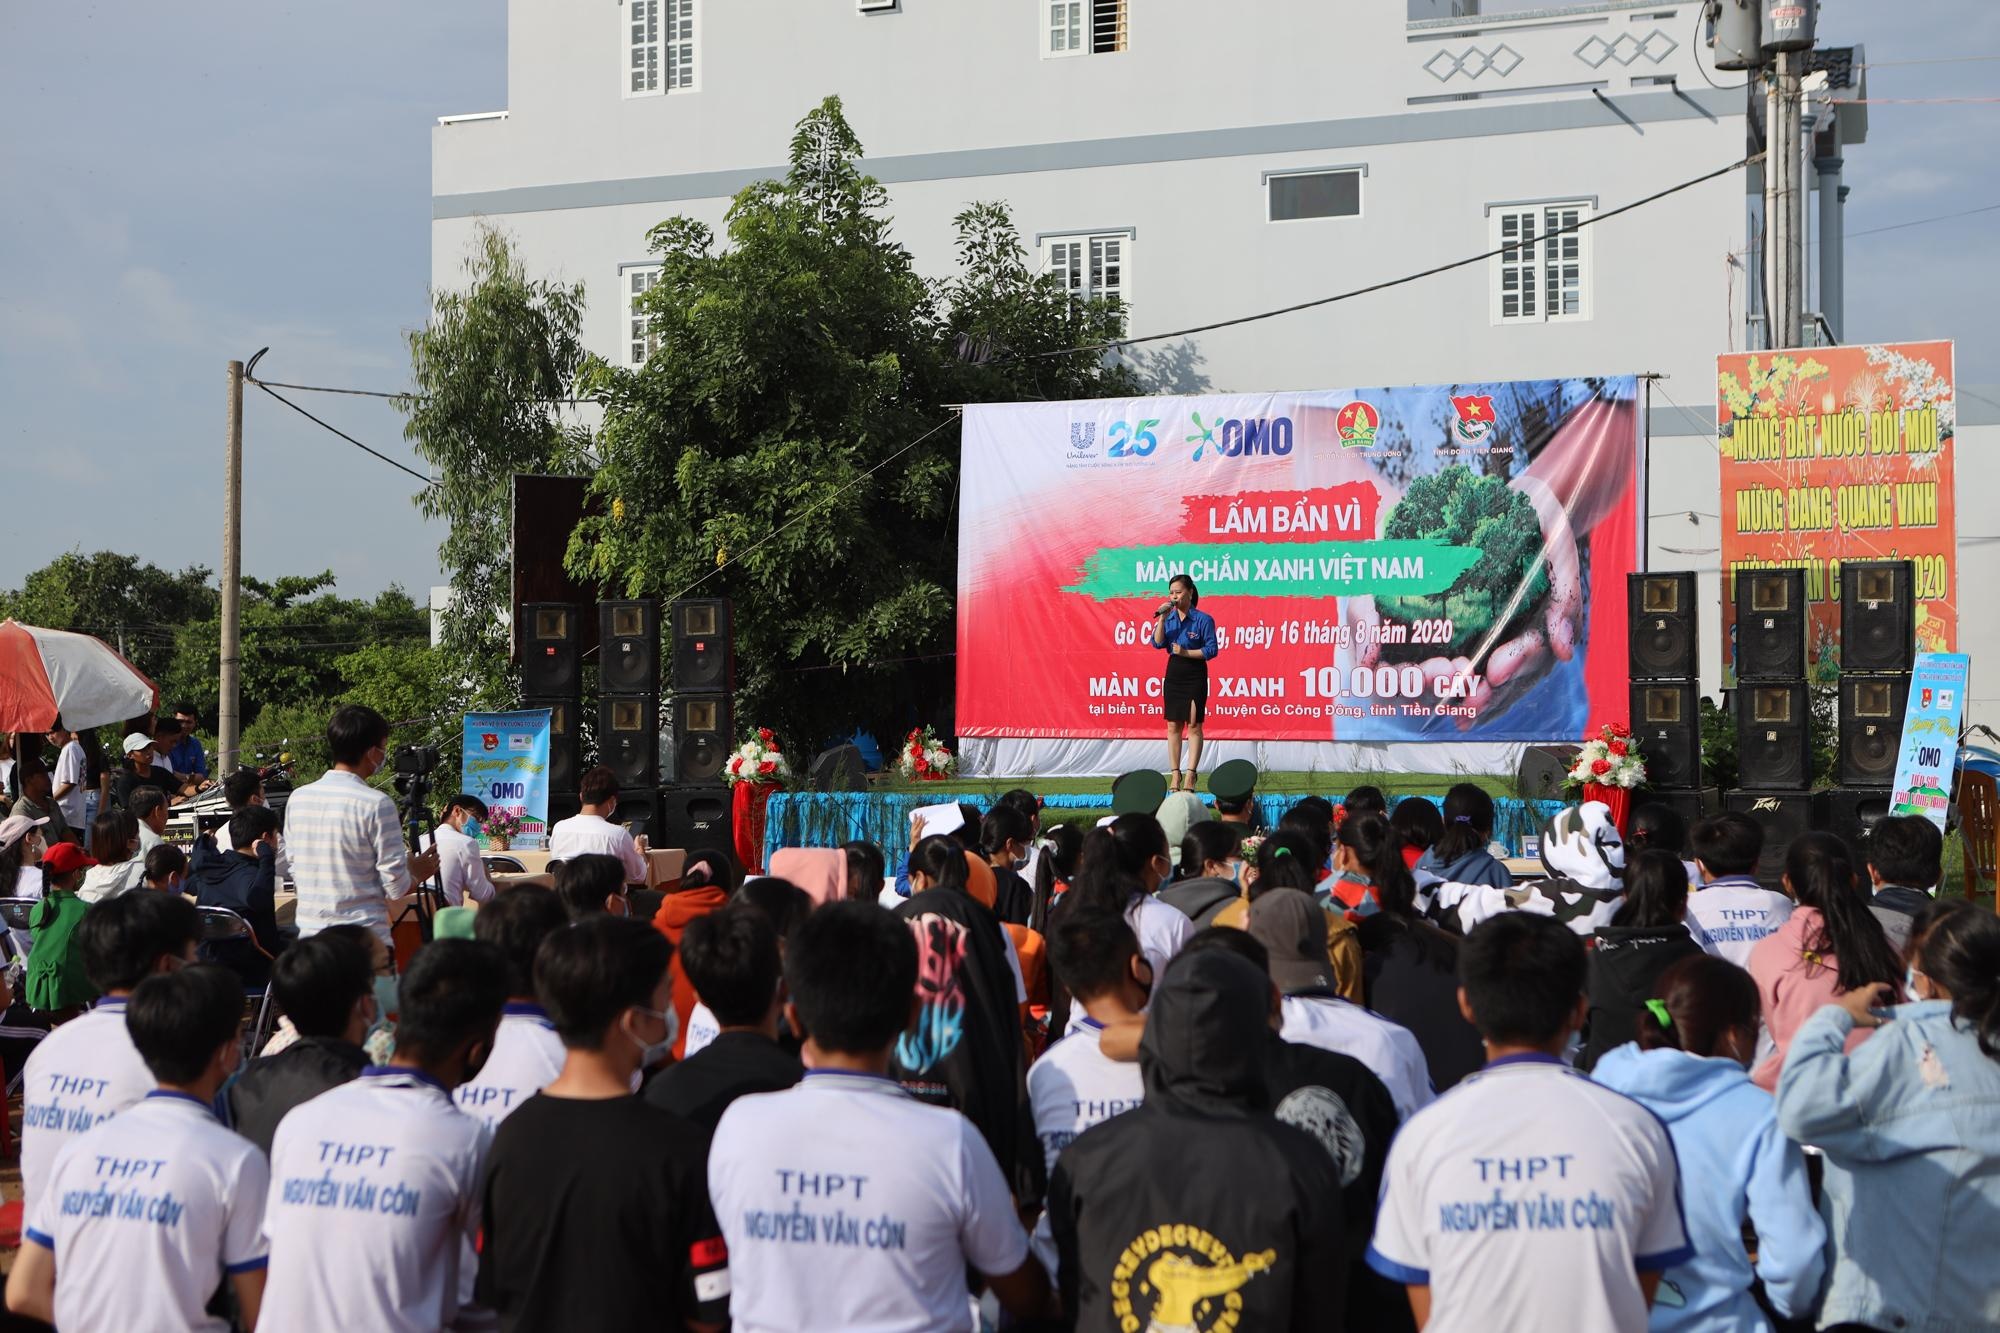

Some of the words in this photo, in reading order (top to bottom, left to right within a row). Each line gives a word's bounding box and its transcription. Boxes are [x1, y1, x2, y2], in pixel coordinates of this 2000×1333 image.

[1107, 419, 1161, 458] 25
[1222, 416, 1294, 457] OMO
[1734, 413, 1781, 463] MỪNG
[1785, 401, 1817, 460] ĐẤT
[1821, 404, 1868, 458] NƯỚC
[1871, 397, 1901, 456] ĐỔI
[1905, 405, 1938, 455] MỚI
[1490, 446, 1514, 454] GIANG
[1209, 499, 1267, 534] LẤM
[1272, 496, 1328, 532] BẨN
[1334, 497, 1361, 531] VÌ
[1736, 483, 1785, 534] MỪNG
[1788, 477, 1833, 531] ĐẢNG
[1837, 483, 1894, 534] QUANG
[1896, 482, 1938, 528] VINH
[1136, 556, 1184, 582] MÀN
[1188, 552, 1250, 581] CHẮN
[1254, 558, 1314, 581] XANH
[1319, 552, 1367, 585] VIỆT
[1371, 556, 1424, 580] NAM
[1114, 621, 1136, 645] Gò
[1234, 620, 1275, 649] ngày
[1280, 620, 1299, 645] 16
[1303, 619, 1351, 649] tháng
[1355, 620, 1366, 644] 8
[1370, 619, 1406, 644] năm
[1411, 619, 1453, 644] 2020
[1089, 672, 1139, 697] MÀN
[1218, 677, 1285, 697] XANH
[1300, 666, 1424, 698] 10.000
[1434, 673, 1481, 697] CÂY
[1089, 703, 1105, 719] tại
[1108, 701, 1135, 715] biển
[1139, 703, 1163, 715] Tân
[1216, 703, 1257, 719] huyện
[1261, 703, 1281, 716] Gò
[1284, 704, 1321, 719] Công
[1325, 703, 1366, 719] Đông,
[1369, 702, 1396, 716] tỉnh
[1401, 702, 1431, 716] Tiền
[1434, 704, 1477, 719] Giang
[1918, 746, 1941, 768] OMO
[491, 782, 525, 799] OMO
[520, 822, 544, 833] ANH
[1719, 910, 1769, 920] THPT
[1703, 922, 1744, 945] NGUYỄN
[1745, 923, 1767, 941] VĂN
[50, 1074, 111, 1098] THPT
[460, 1087, 517, 1107] HPT
[67, 1105, 93, 1133] VĂN
[95, 1155, 168, 1181] THPT
[318, 1141, 395, 1169] THPT
[1472, 1154, 1577, 1183] THPT
[282, 1168, 340, 1208] NGUYỄN
[344, 1178, 377, 1211] VĂN
[379, 1181, 421, 1217] CÔN
[774, 1168, 869, 1201] THPT
[61, 1174, 116, 1217] NGUYỄN
[117, 1186, 144, 1220] VĂN
[147, 1193, 184, 1228] CÔN
[1439, 1189, 1518, 1232] NGUYỄN
[1523, 1194, 1567, 1232] VĂN
[1570, 1193, 1616, 1232] CÔN
[744, 1200, 819, 1245] NGUYỄN
[821, 1206, 862, 1250] VĂN
[864, 1212, 907, 1251] CÔN
